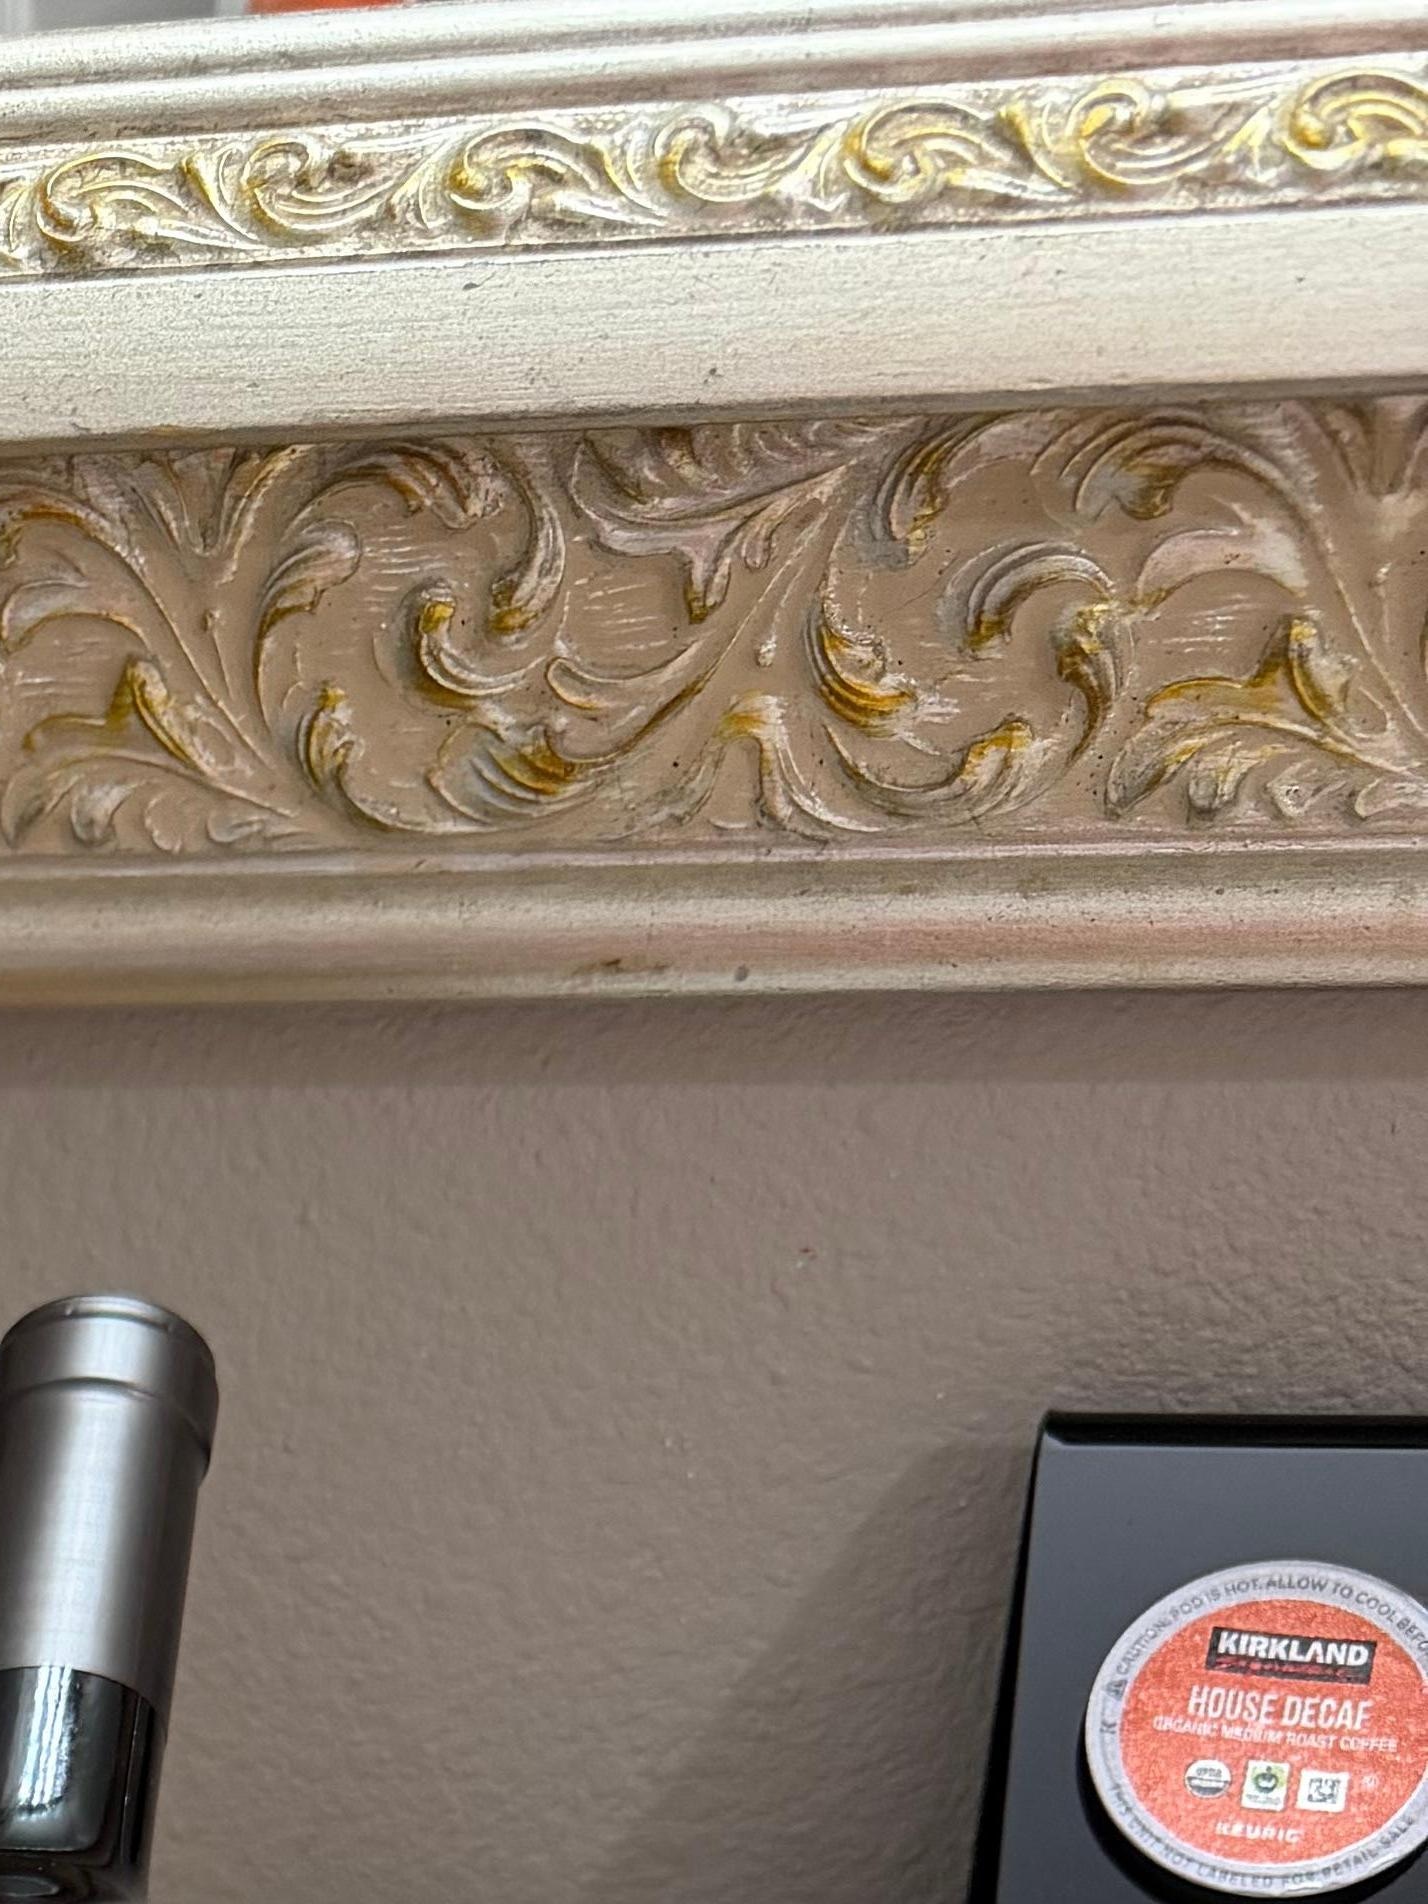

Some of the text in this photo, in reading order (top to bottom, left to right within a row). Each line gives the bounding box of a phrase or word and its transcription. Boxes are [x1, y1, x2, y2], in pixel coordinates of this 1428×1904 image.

[1266, 1574, 1330, 1592] ALLOW
[1332, 1581, 1354, 1600] TO
[1354, 1591, 1396, 1624] COOL
[1216, 1630, 1370, 1666] KIRKLAND
[1187, 1684, 1374, 1731] HOUSE DECAF
[1151, 1715, 1398, 1753] ORGANIC MEDIUM ROAST COFFEE
[1215, 1819, 1304, 1844] KEURIG
[1163, 1844, 1194, 1866] NOT
[1196, 1861, 1273, 1888] LABELED
